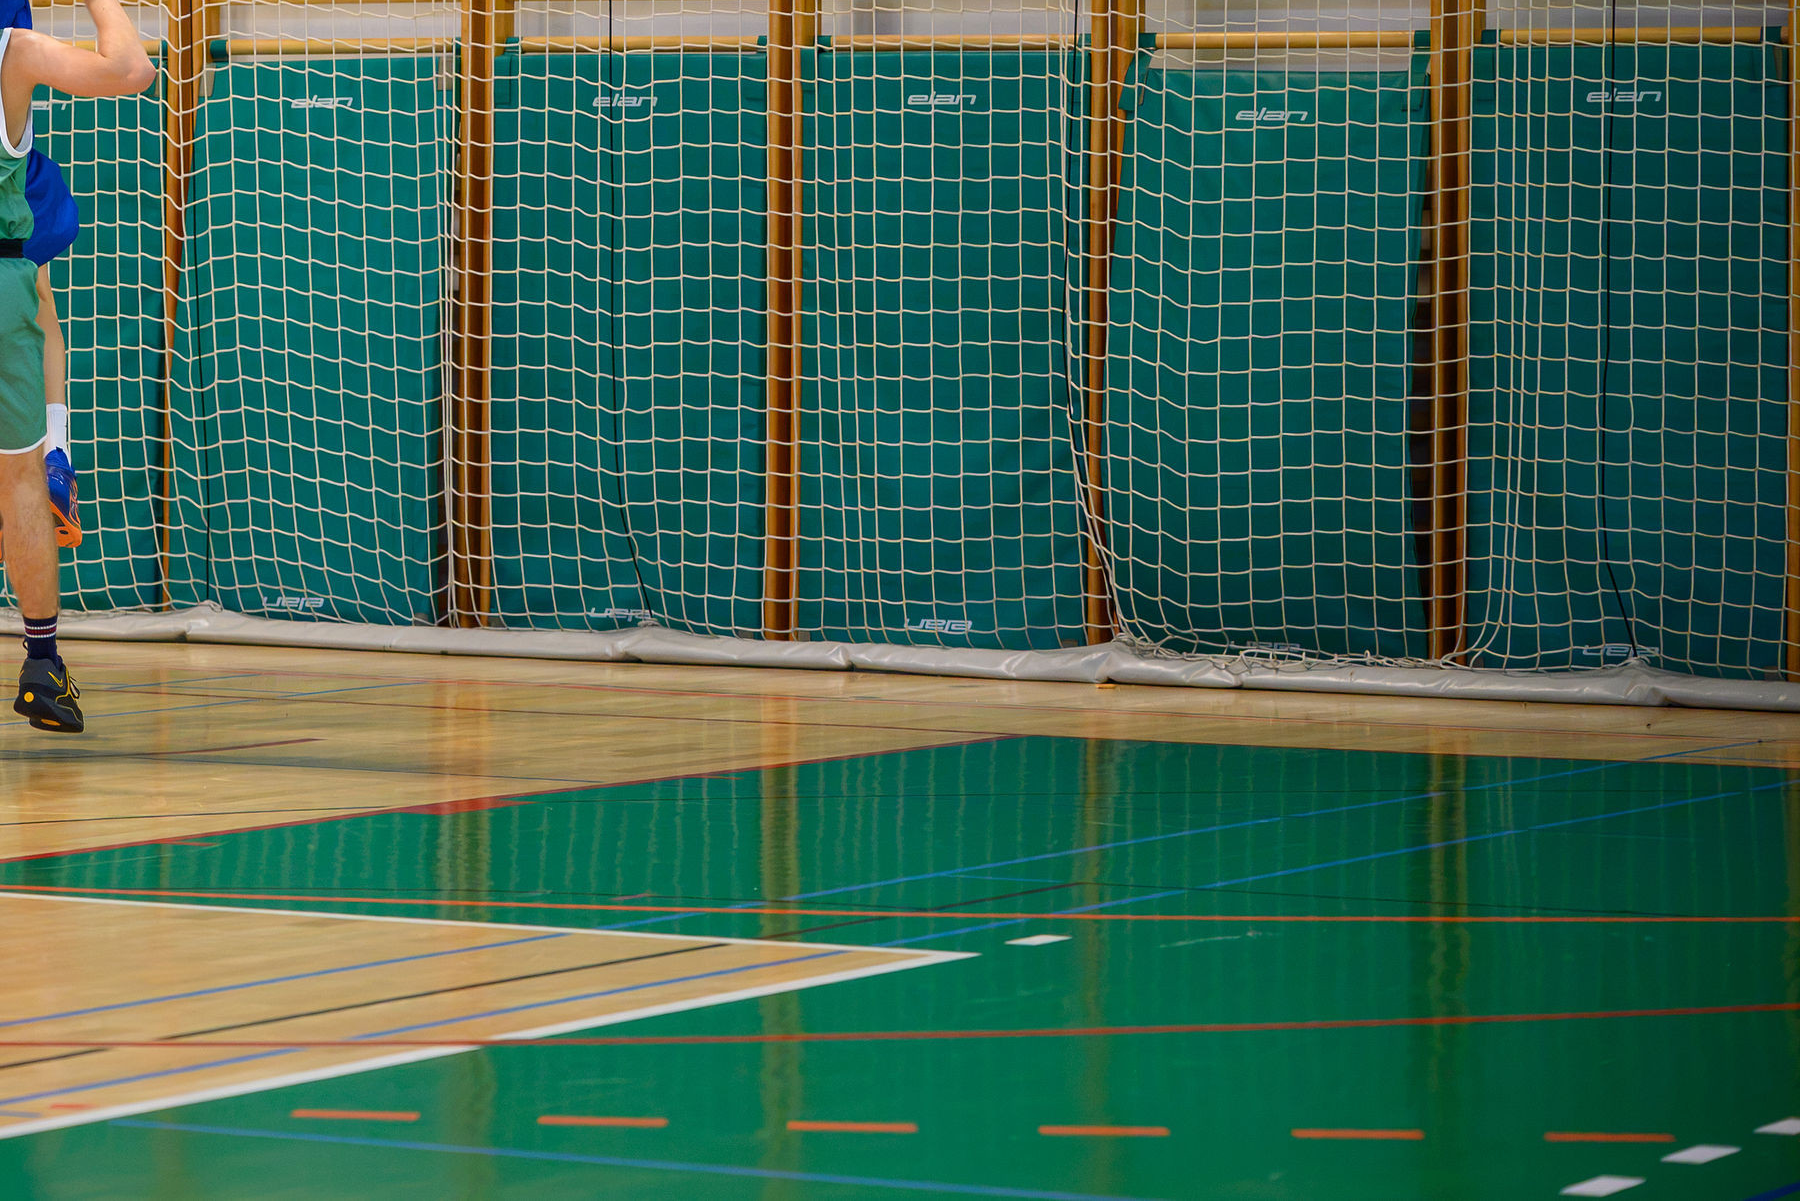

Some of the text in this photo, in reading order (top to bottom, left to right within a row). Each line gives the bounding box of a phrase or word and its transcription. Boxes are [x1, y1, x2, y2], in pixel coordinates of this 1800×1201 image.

[593, 94, 658, 107] elan
[907, 91, 976, 105] elan
[1586, 88, 1662, 102] elan
[1236, 107, 1308, 121] elan
